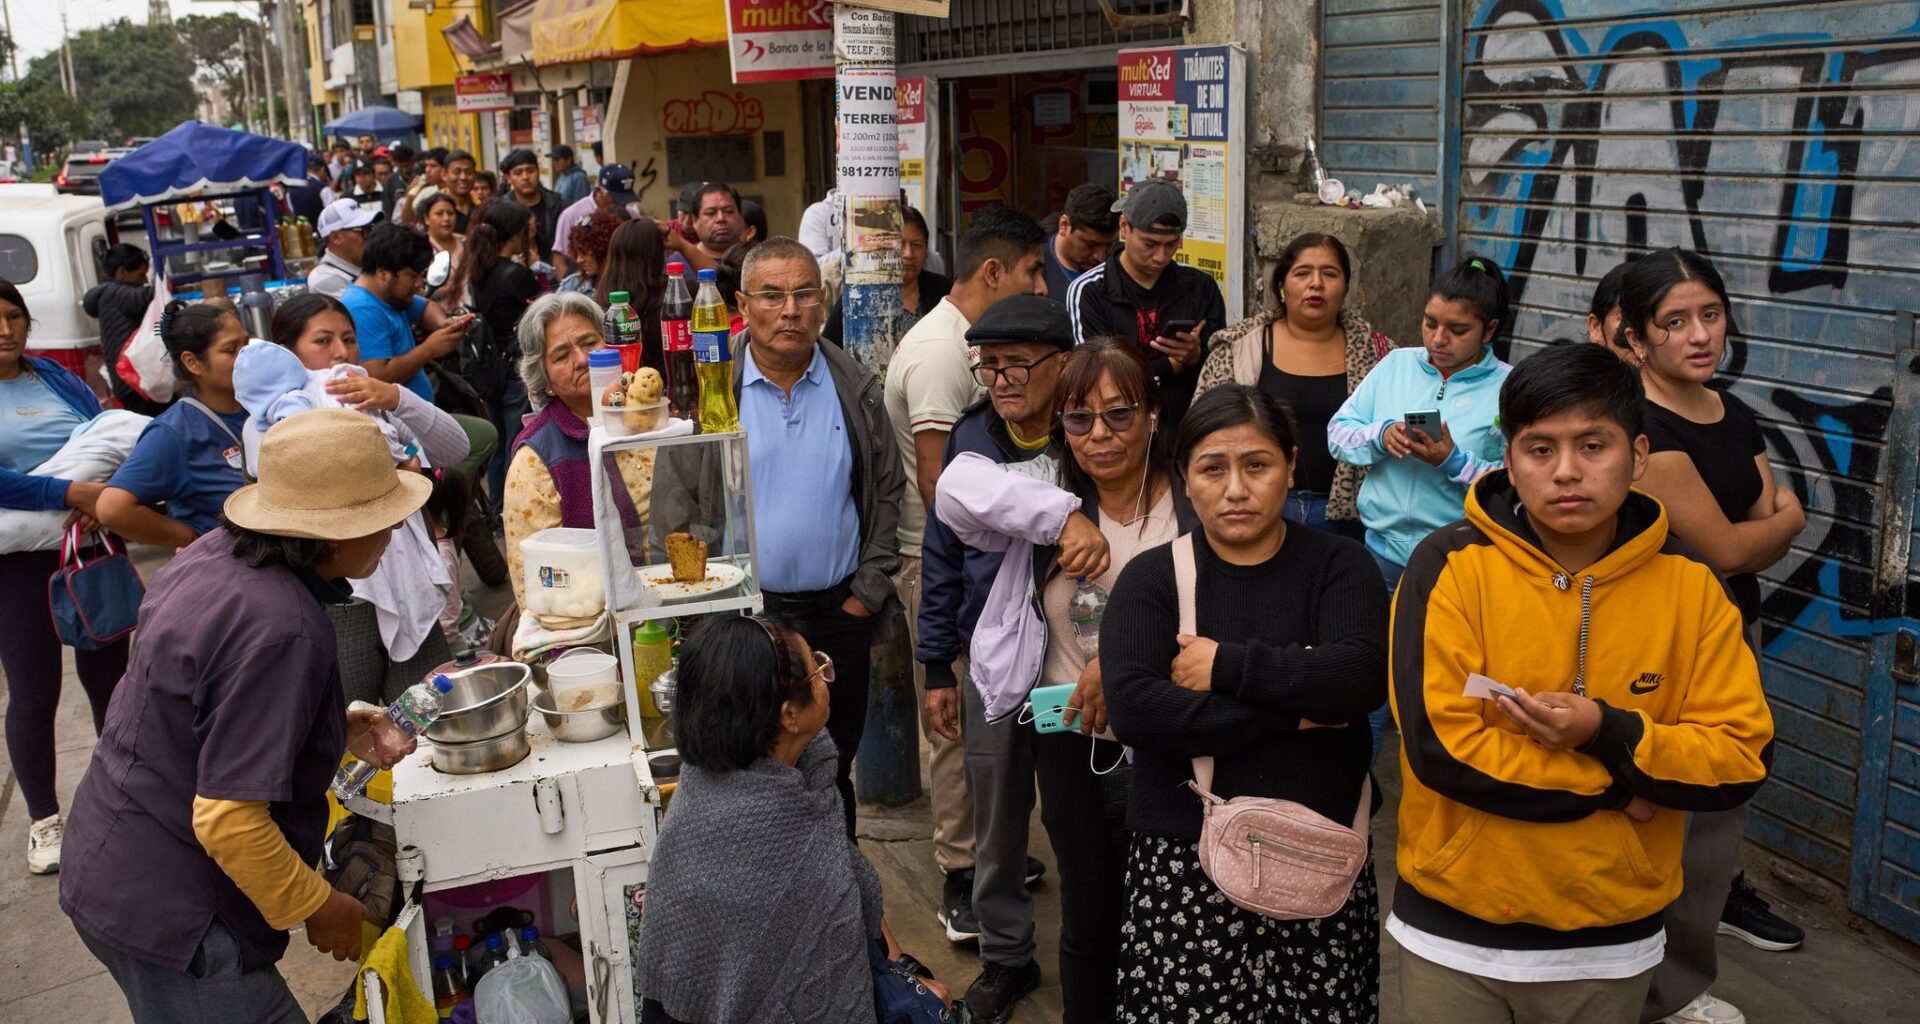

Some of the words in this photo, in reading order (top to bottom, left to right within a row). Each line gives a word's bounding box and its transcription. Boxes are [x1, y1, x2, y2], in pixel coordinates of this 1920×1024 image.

[742, 0, 834, 27] multiRe
[851, 12, 869, 21] Con
[769, 42, 799, 54] Banco
[802, 41, 814, 52] de
[817, 39, 826, 51] la
[1184, 51, 1224, 81] TRÁMITES
[1129, 83, 1162, 97] VIRTUAL
[1197, 84, 1208, 109] DE
[1209, 84, 1224, 109] DNI
[843, 113, 897, 124] TERREN
[1190, 112, 1224, 137] VIRTUAL
[841, 166, 899, 177] 98127751
[1639, 672, 1666, 684] NIKE
